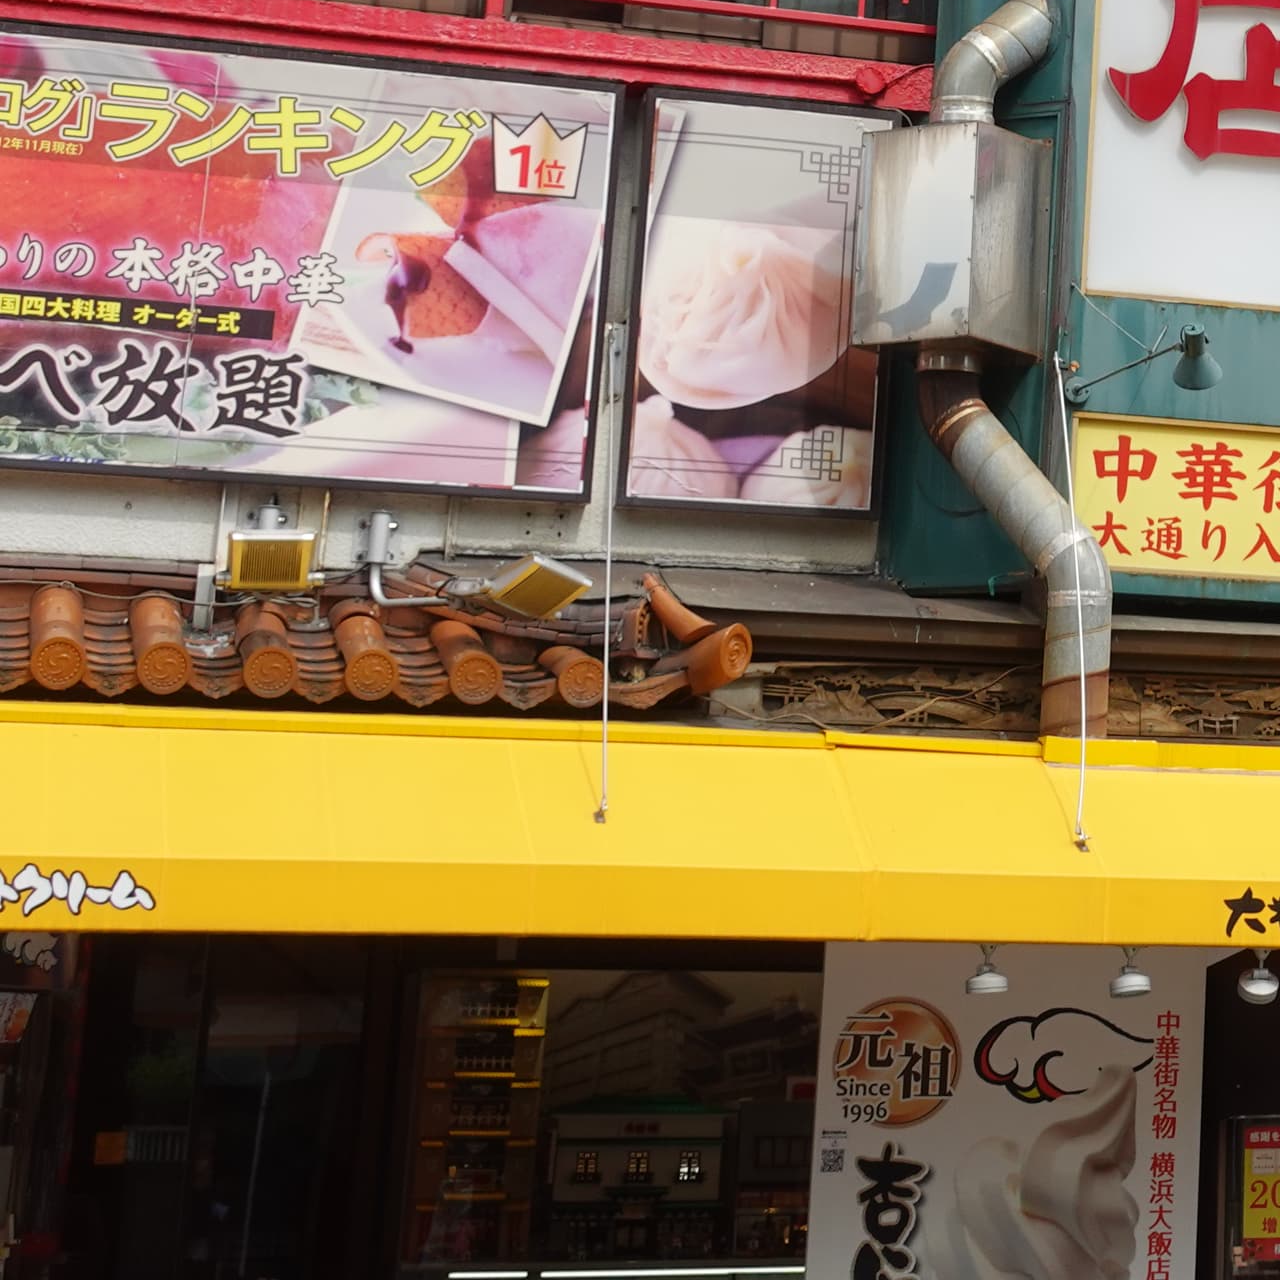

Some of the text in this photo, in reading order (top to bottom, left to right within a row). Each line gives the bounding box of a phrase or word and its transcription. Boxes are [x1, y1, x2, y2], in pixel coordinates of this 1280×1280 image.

[0, 137, 84, 156] 2年11月現在）
[508, 143, 567, 190] 1位
[132, 304, 241, 334] オーダー式
[0, 340, 306, 438] べ放題
[836, 1012, 953, 1101] 元祖
[836, 1078, 891, 1098] Since
[842, 1101, 888, 1122] 1996
[1146, 1010, 1181, 1280] 中華街名物 横浜大飯店
